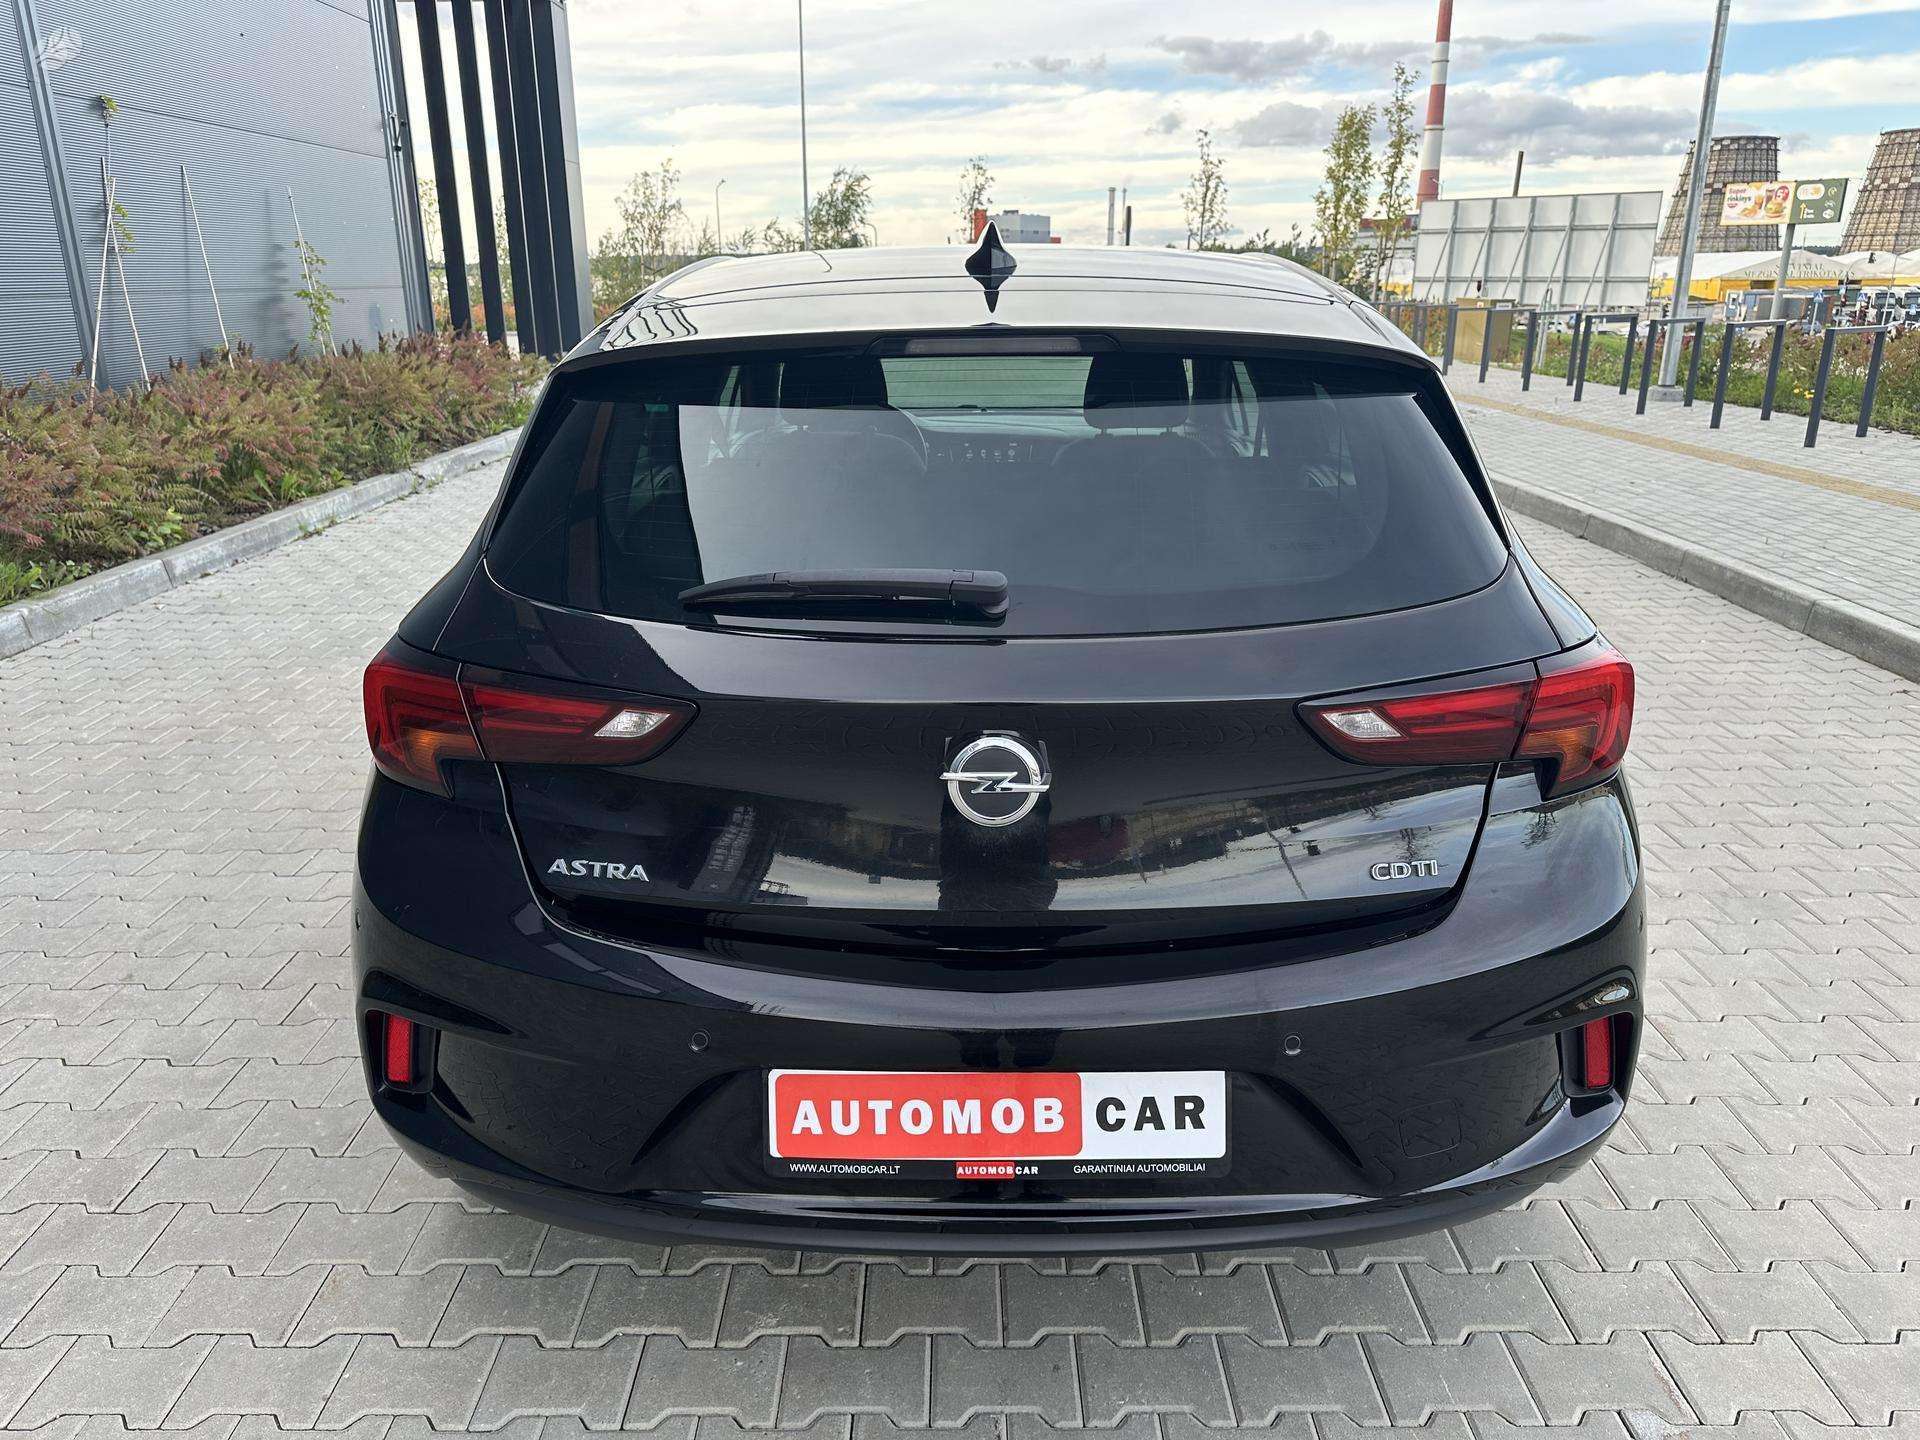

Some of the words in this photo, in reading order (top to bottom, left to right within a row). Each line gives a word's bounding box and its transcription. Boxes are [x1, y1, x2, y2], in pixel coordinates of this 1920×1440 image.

[547, 858, 650, 882] ASTRA
[1371, 859, 1438, 880] CDTI
[791, 1096, 1066, 1136] AUTOMOB
[1095, 1095, 1206, 1133] CAR
[789, 1164, 900, 1175] WWW.AUTOMOBCAR.LT
[1073, 1164, 1135, 1174] GARANTINIAI
[1137, 1163, 1206, 1173] AUTOMOBILIAI
